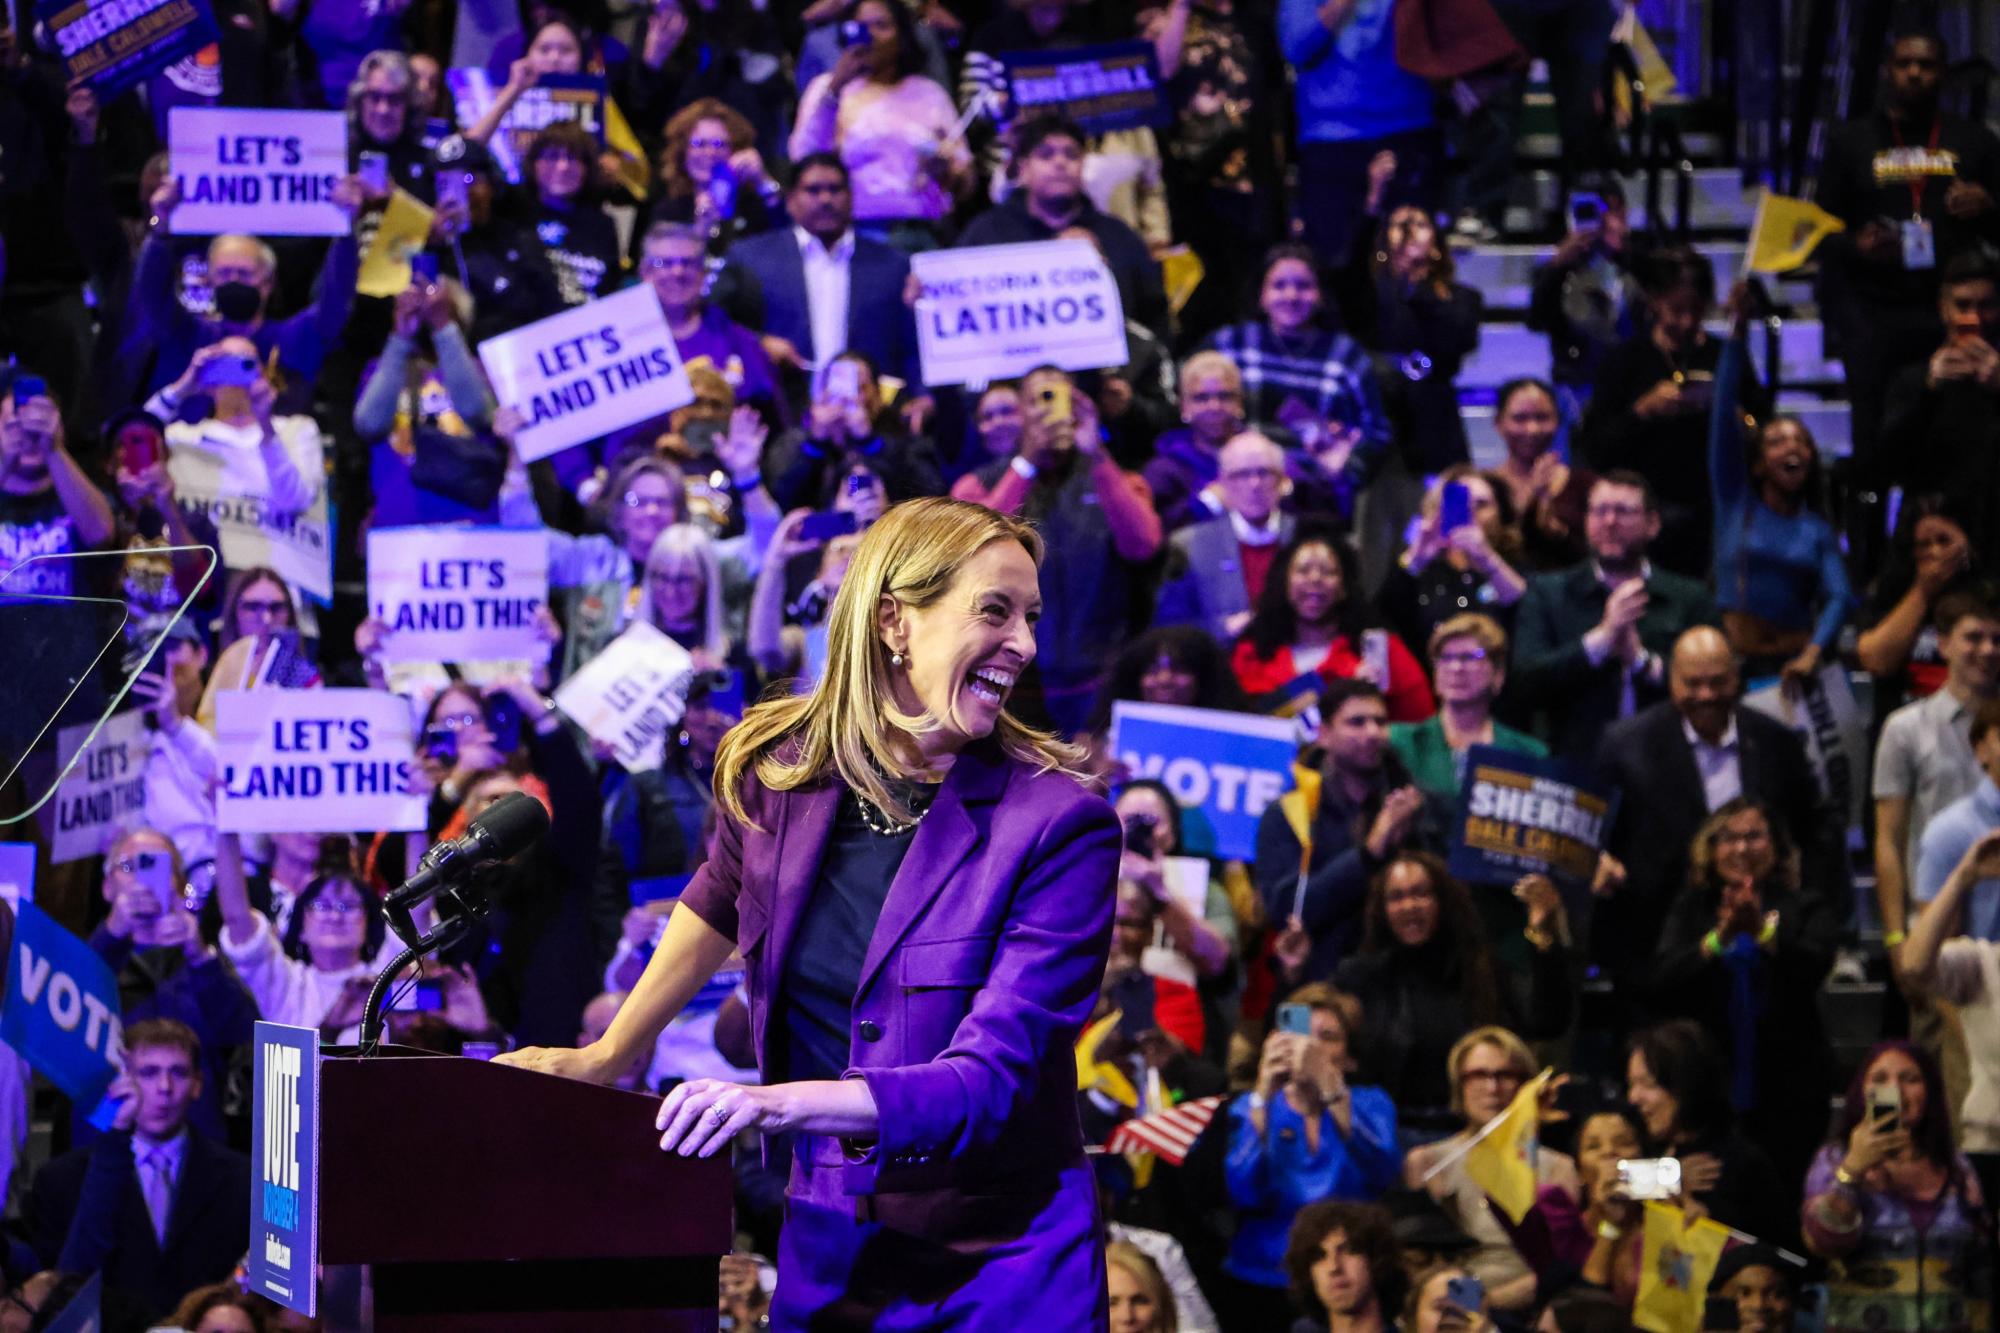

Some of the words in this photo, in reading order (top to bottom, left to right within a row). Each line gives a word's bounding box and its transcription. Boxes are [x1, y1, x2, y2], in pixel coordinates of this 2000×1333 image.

[218, 135, 301, 166] LET'S
[178, 174, 261, 205] LAND
[932, 293, 1106, 340] LATINOS
[536, 326, 622, 378] LET'S
[597, 347, 672, 396] THIS
[421, 559, 505, 589] LET'S
[274, 719, 370, 752] LET'S
[87, 741, 128, 784] LET'S
[226, 764, 323, 799] LAND
[60, 787, 114, 832] LAND
[263, 1042, 301, 1191] VOTE
[263, 1180, 294, 1233] NOVEMBER
[294, 1191, 299, 1233] 4
